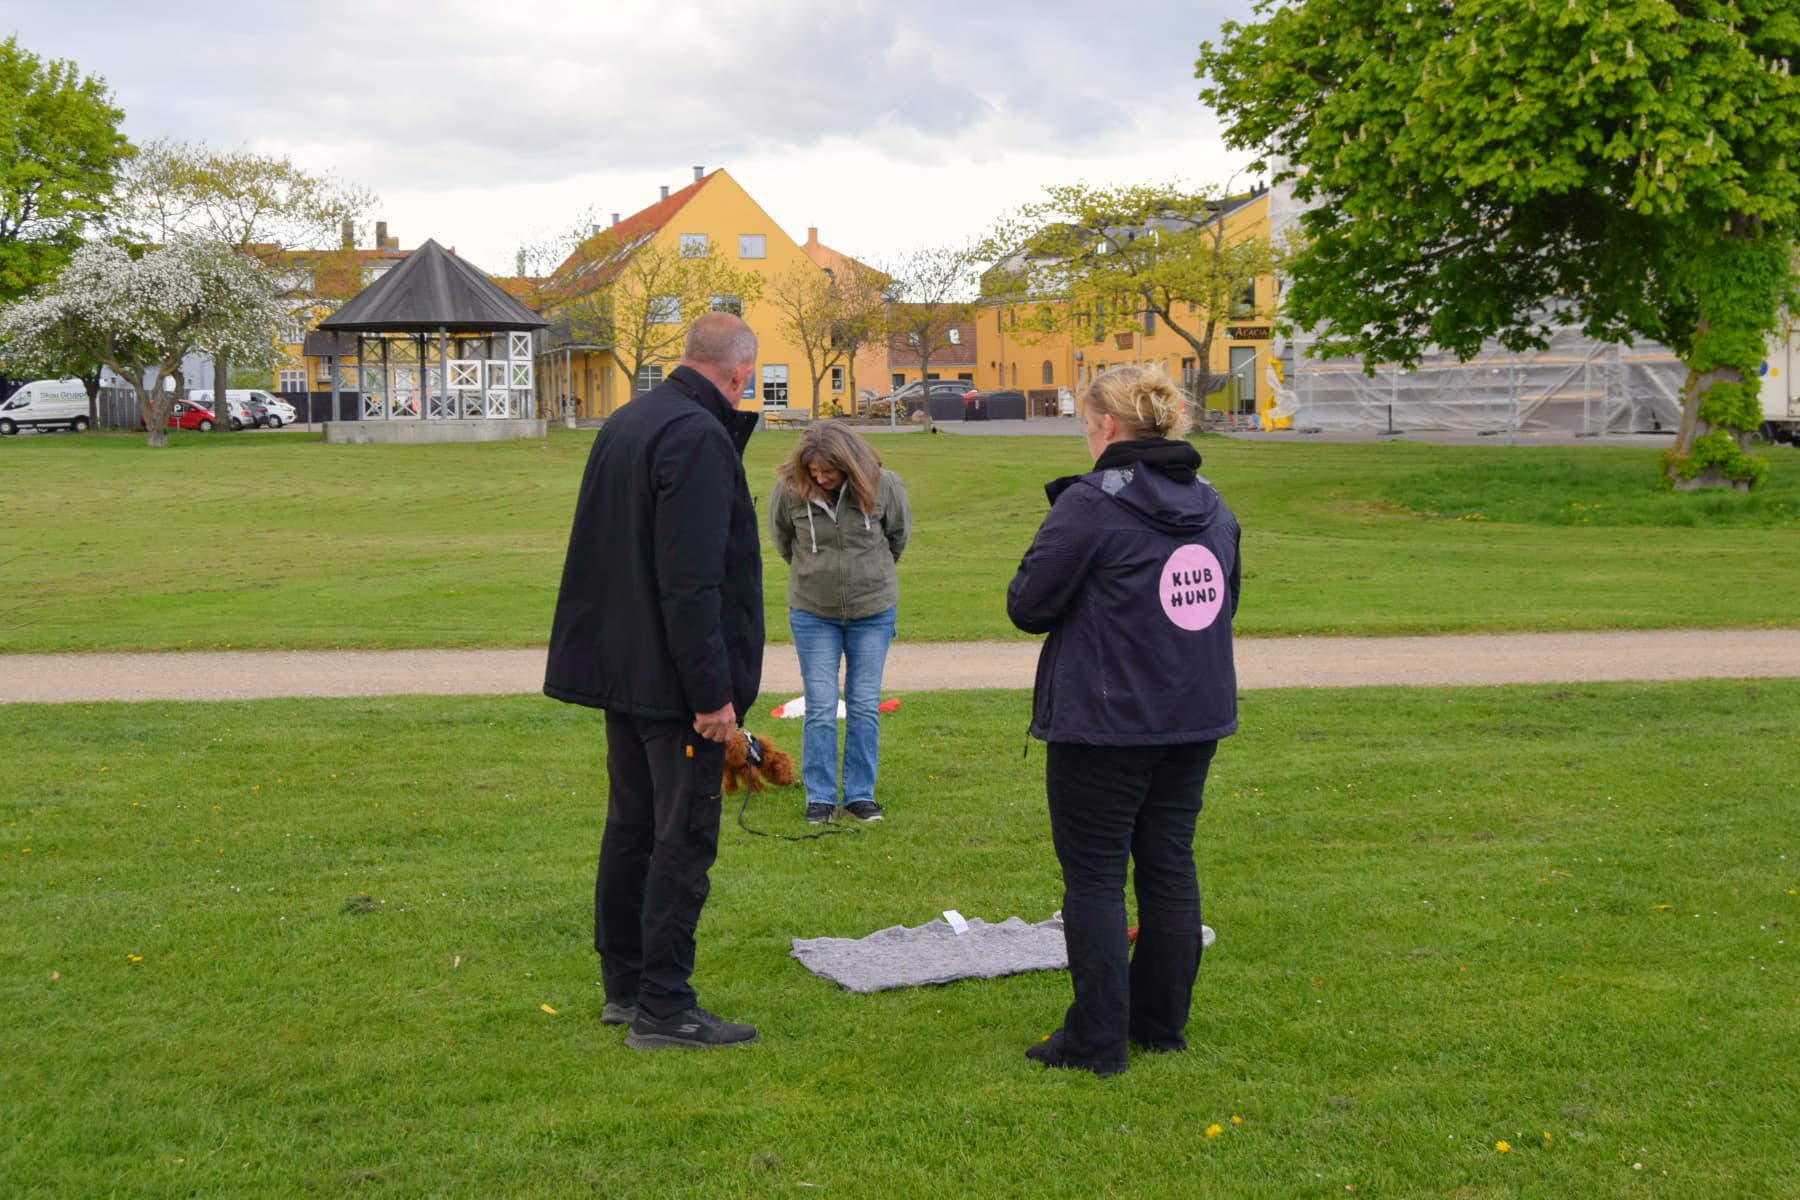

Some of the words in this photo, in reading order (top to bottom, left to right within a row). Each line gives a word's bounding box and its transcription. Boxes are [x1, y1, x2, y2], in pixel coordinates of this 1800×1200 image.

[174, 404, 182, 412] P
[1172, 568, 1213, 587] KLUB
[1171, 587, 1217, 607] HUND
